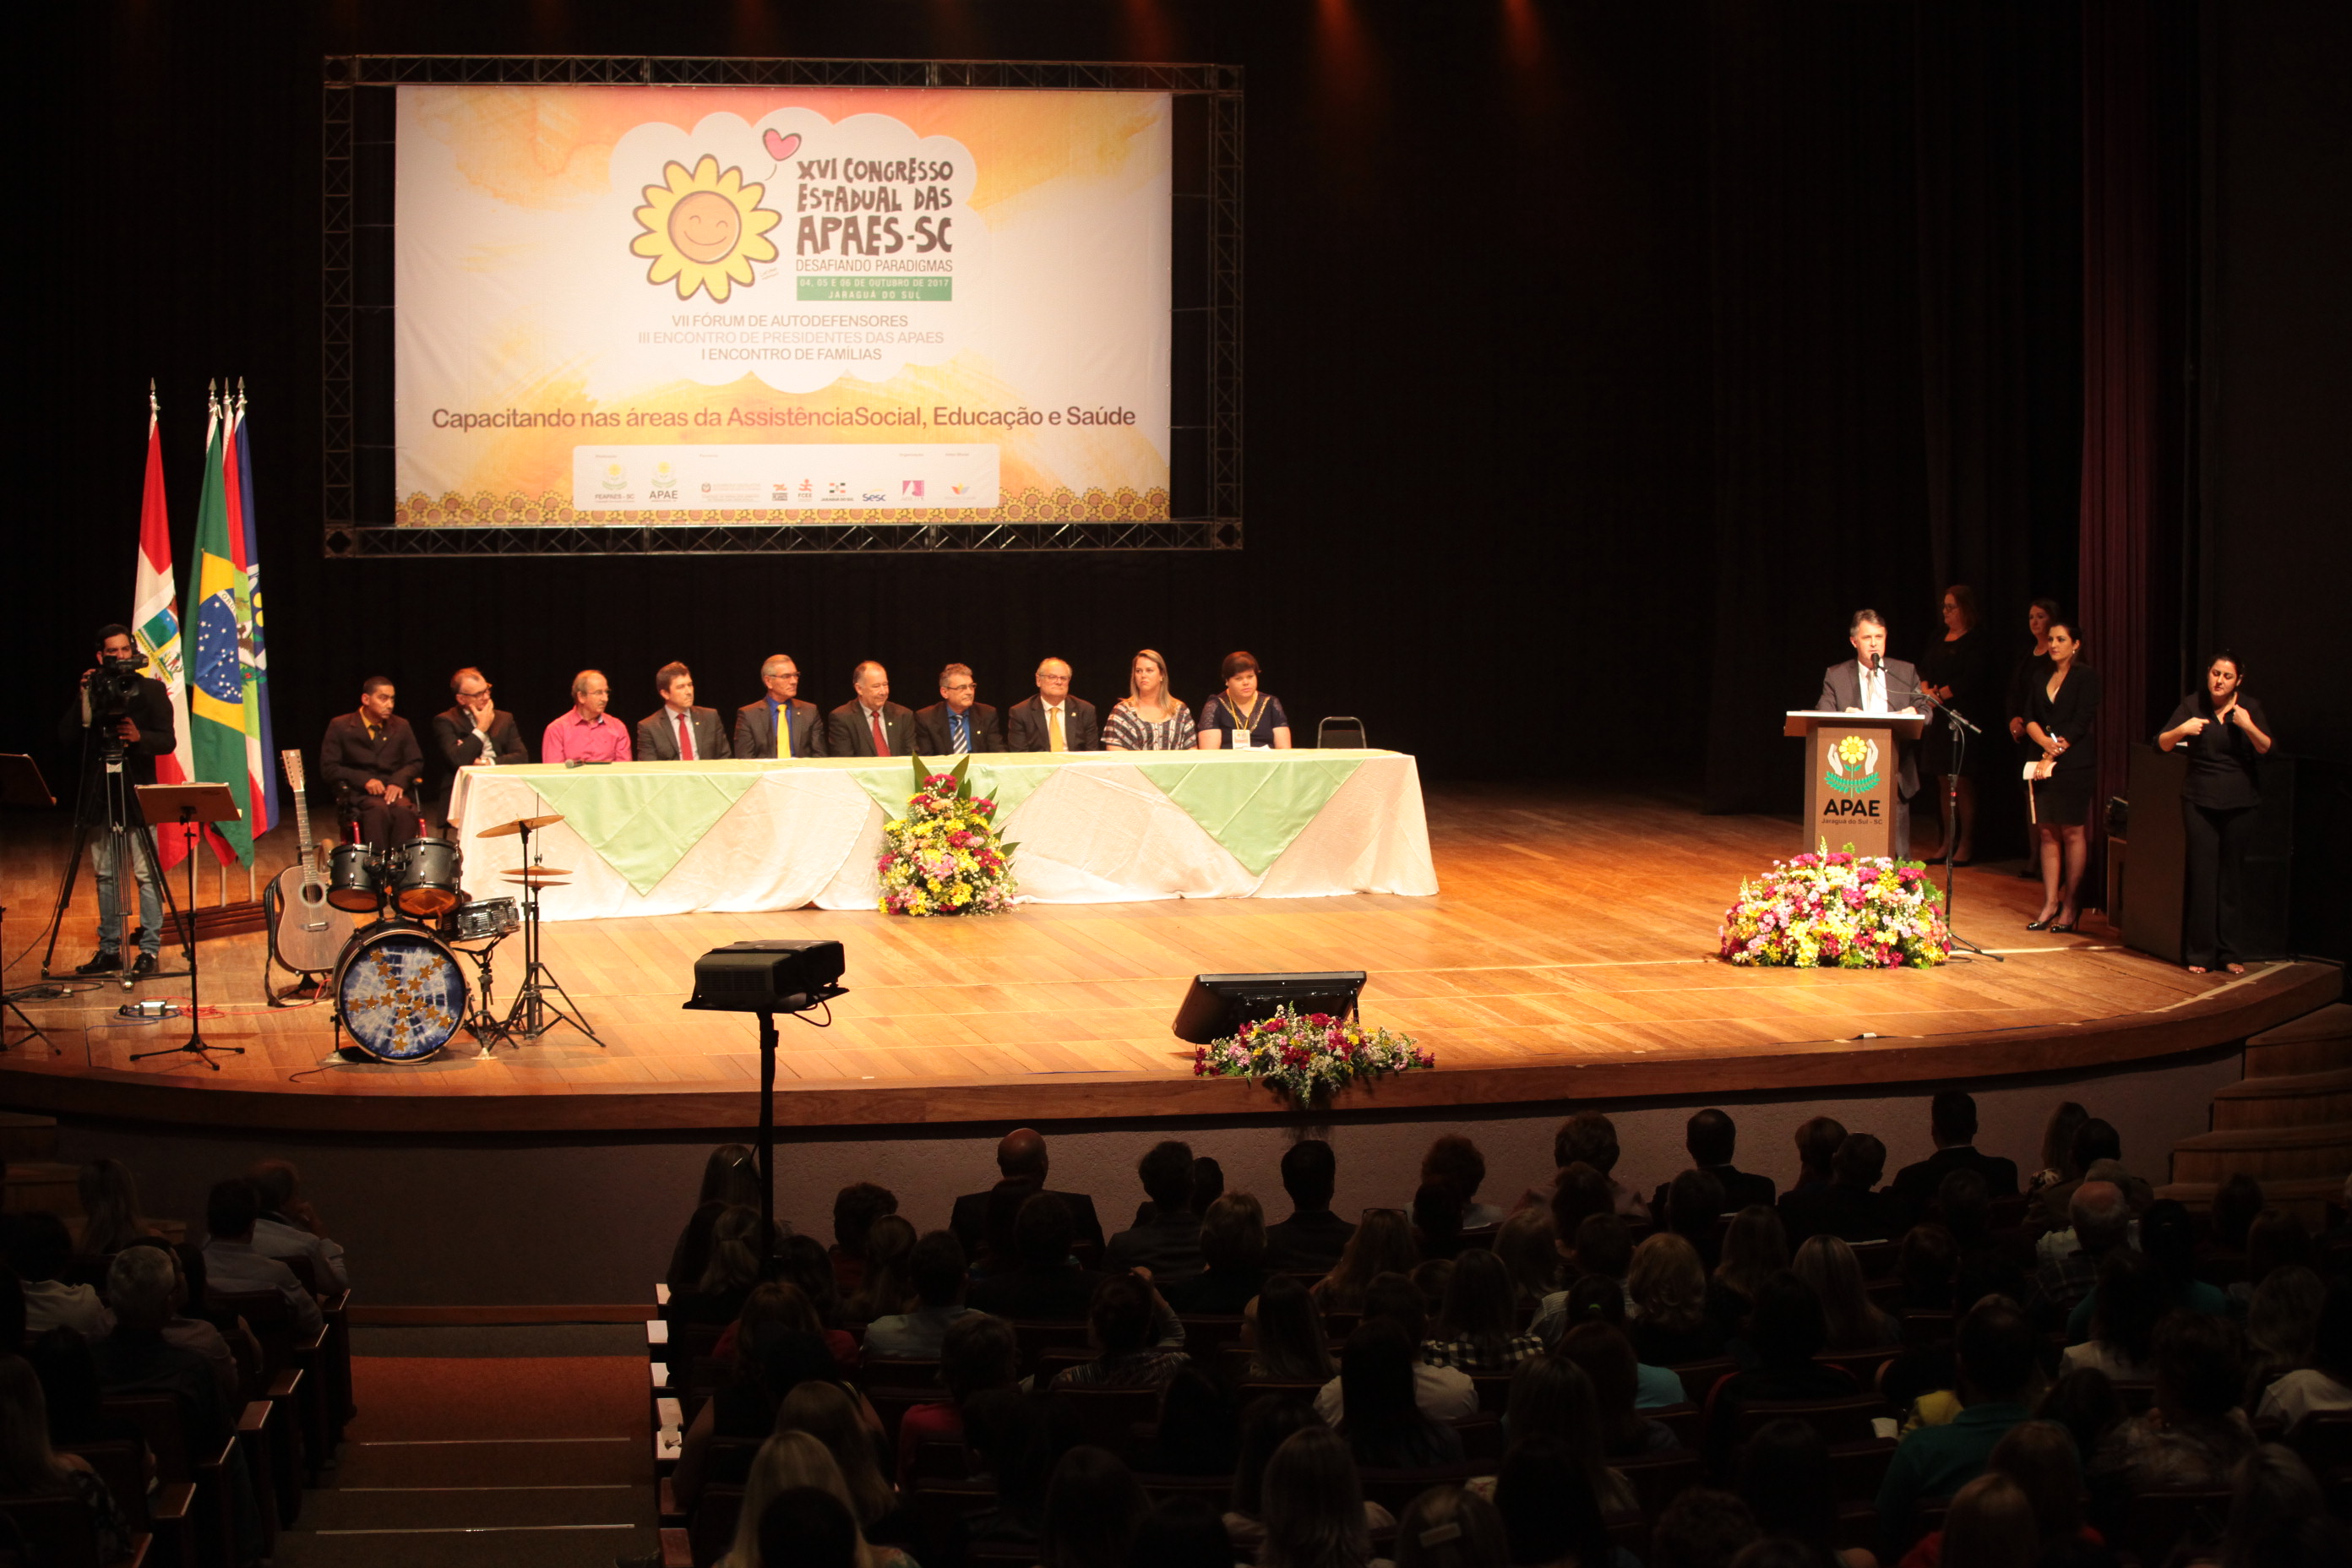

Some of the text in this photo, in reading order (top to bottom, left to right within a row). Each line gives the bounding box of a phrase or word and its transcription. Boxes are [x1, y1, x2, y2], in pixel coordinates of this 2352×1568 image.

[797, 157, 954, 184] XVI CONGRESSO
[797, 183, 953, 212] ESTADUAL DAS
[796, 259, 953, 272] DESAFIANDO PARADIGMAS
[817, 279, 828, 287] 05
[831, 279, 836, 287] E
[840, 279, 851, 287] 06
[854, 279, 865, 287] DE
[868, 279, 909, 287] OUTUBRO
[912, 279, 924, 287] DE
[928, 279, 949, 287] 2017
[828, 290, 877, 300] JARAGUÁ
[672, 312, 908, 327] VII FÓRUM DE AUTODEFENSORES
[639, 332, 944, 344] III ENCONTRO DE PRESIDENTES DAS APAES
[709, 349, 791, 360] ENCONTRO
[795, 349, 814, 360] DE
[818, 346, 882, 360] FAMÍLIAS
[432, 409, 575, 433] Capacitando
[581, 411, 620, 427] nas
[627, 408, 688, 427] áreas
[694, 407, 721, 427] da
[933, 406, 1043, 431] Educação
[1048, 411, 1061, 426] e
[1066, 406, 1136, 426] Saúde
[649, 490, 678, 499] APAE
[1823, 798, 1881, 817] APAE
